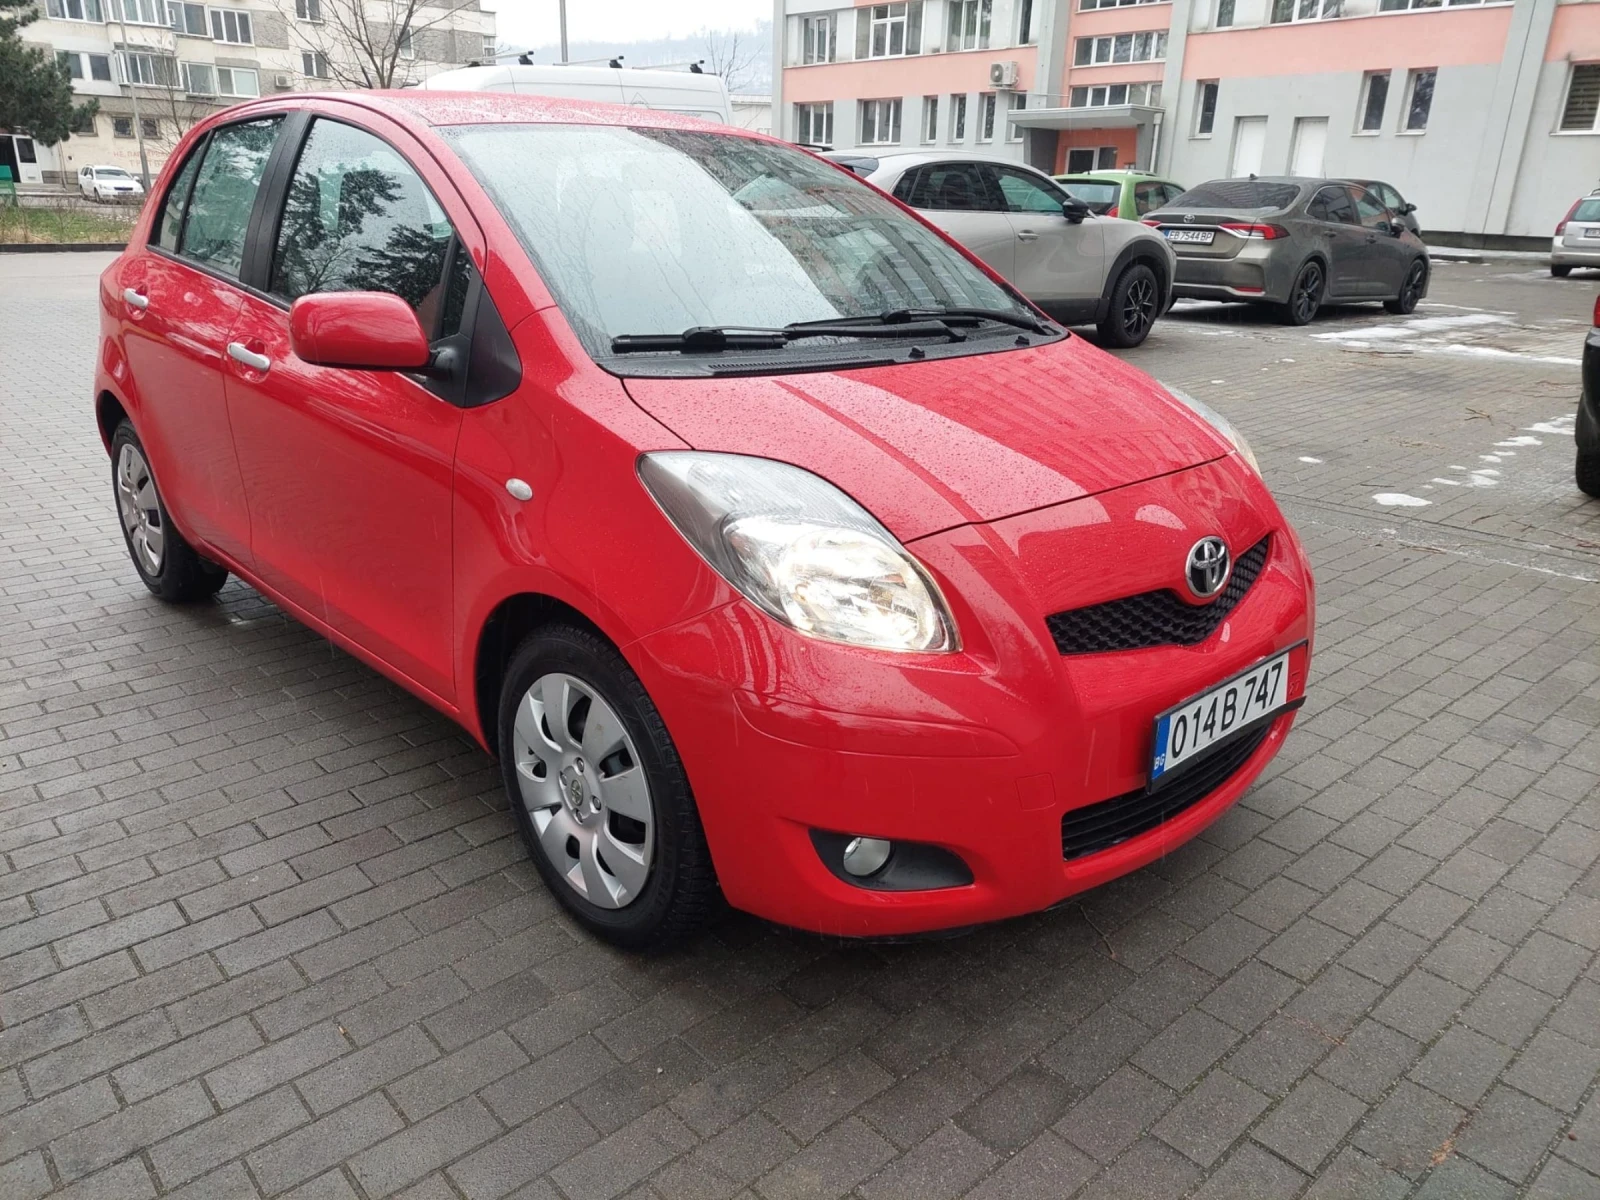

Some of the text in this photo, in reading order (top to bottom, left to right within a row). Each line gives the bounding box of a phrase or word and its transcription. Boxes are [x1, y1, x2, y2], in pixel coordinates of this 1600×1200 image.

[1169, 230, 1213, 242] EB 7544 BP
[1154, 753, 1165, 770] BG
